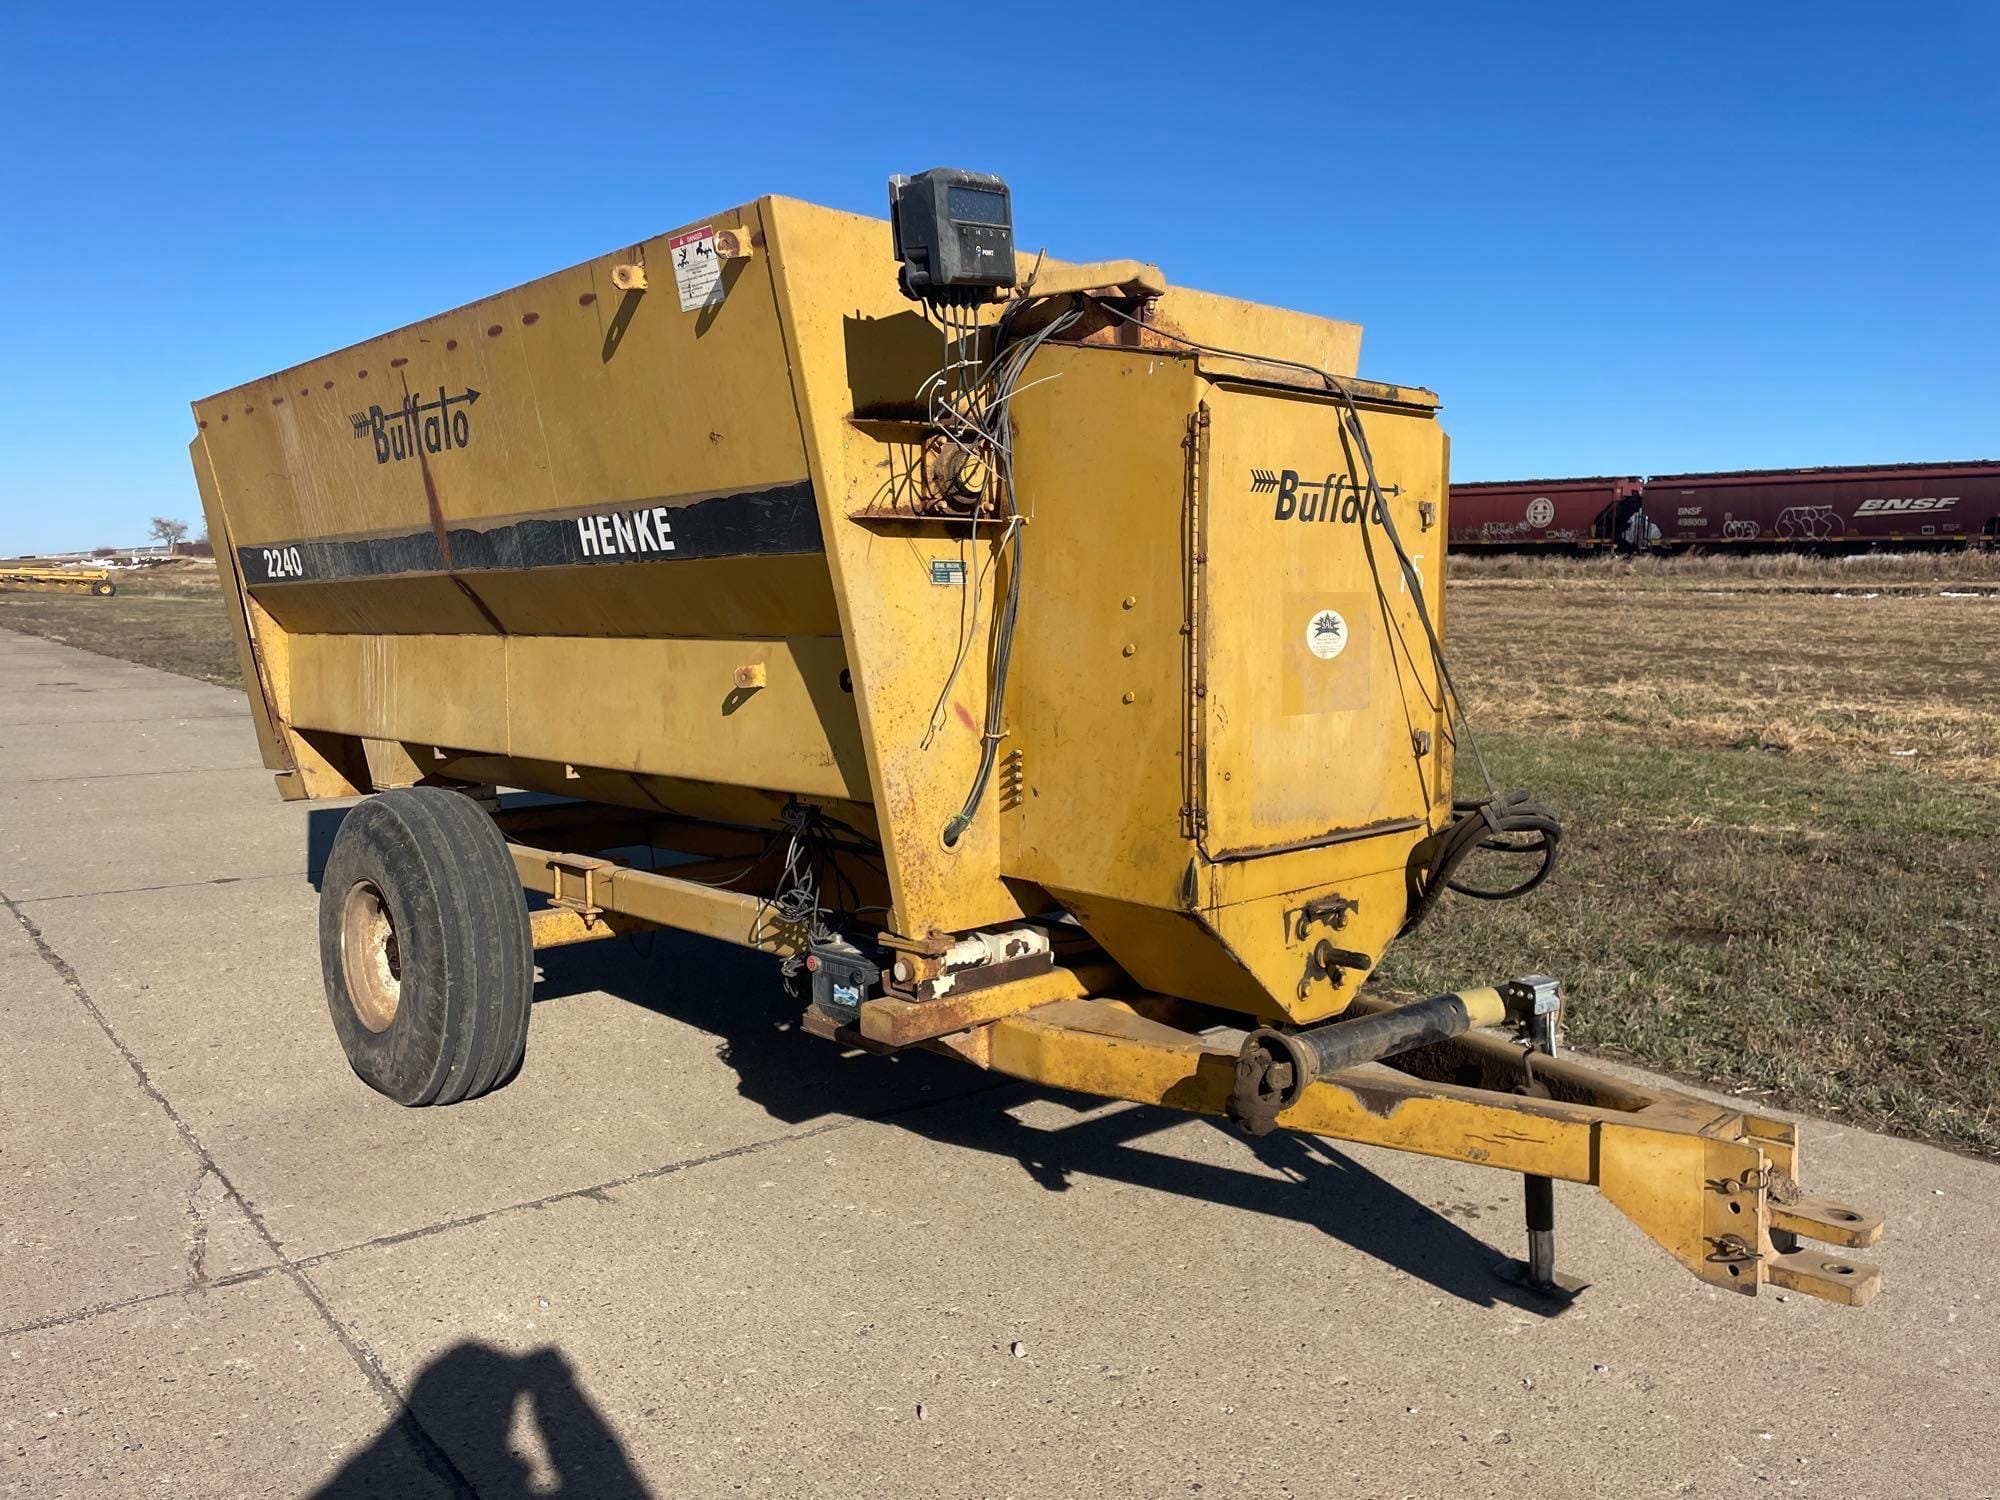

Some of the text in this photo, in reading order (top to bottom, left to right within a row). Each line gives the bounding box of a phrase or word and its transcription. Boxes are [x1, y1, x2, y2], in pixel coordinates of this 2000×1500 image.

[368, 385, 469, 465] Buffalo
[1274, 469, 1388, 526] Buffalo
[1678, 506, 1703, 516] BNSF
[1858, 497, 1960, 510] BNSF
[577, 507, 676, 557] HENKE
[263, 546, 303, 578] 2240
